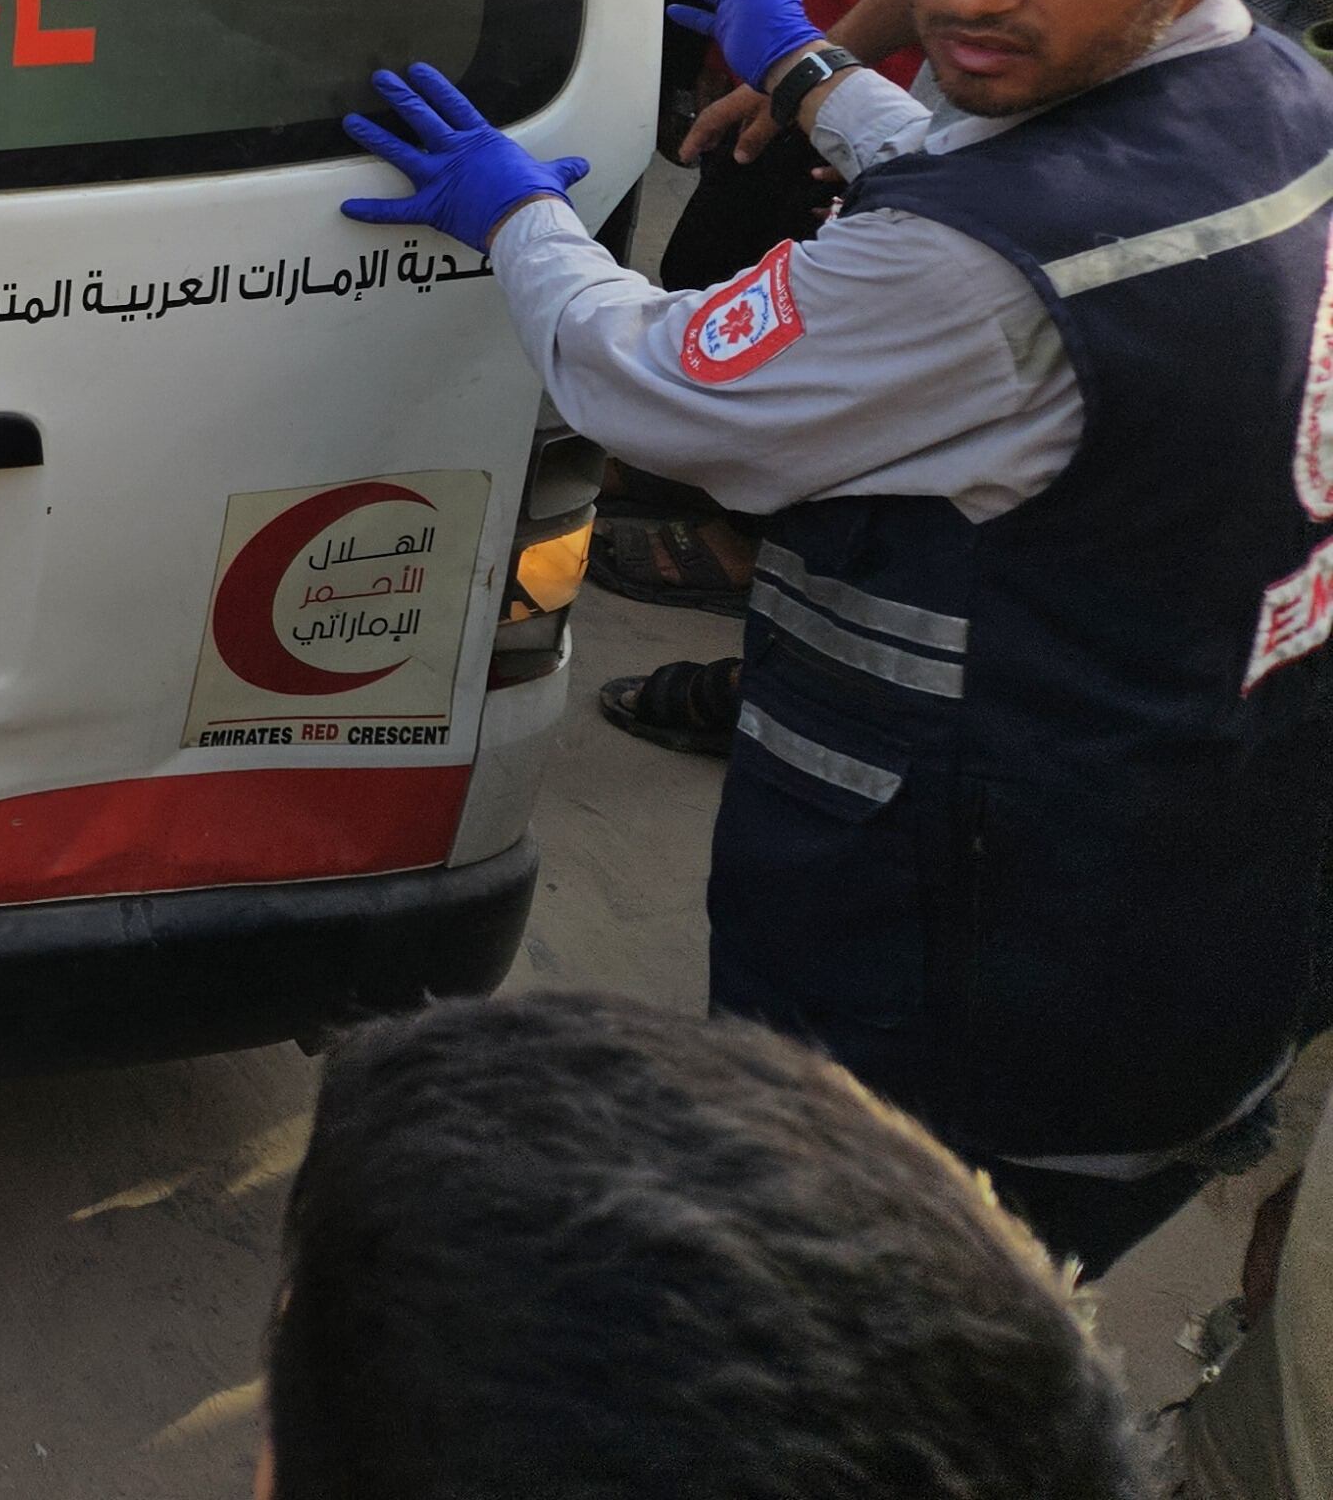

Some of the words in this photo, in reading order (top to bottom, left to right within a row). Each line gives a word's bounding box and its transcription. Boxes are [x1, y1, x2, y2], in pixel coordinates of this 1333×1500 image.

[82, 263, 230, 322] العربية
[239, 248, 389, 302] الإمارات
[308, 527, 435, 571] الهلال
[299, 565, 424, 610] الأحمر
[292, 608, 421, 646] الإماراتي
[198, 726, 293, 748] EMIRATES
[301, 723, 339, 741] RED
[347, 725, 450, 746] CRESCENT
